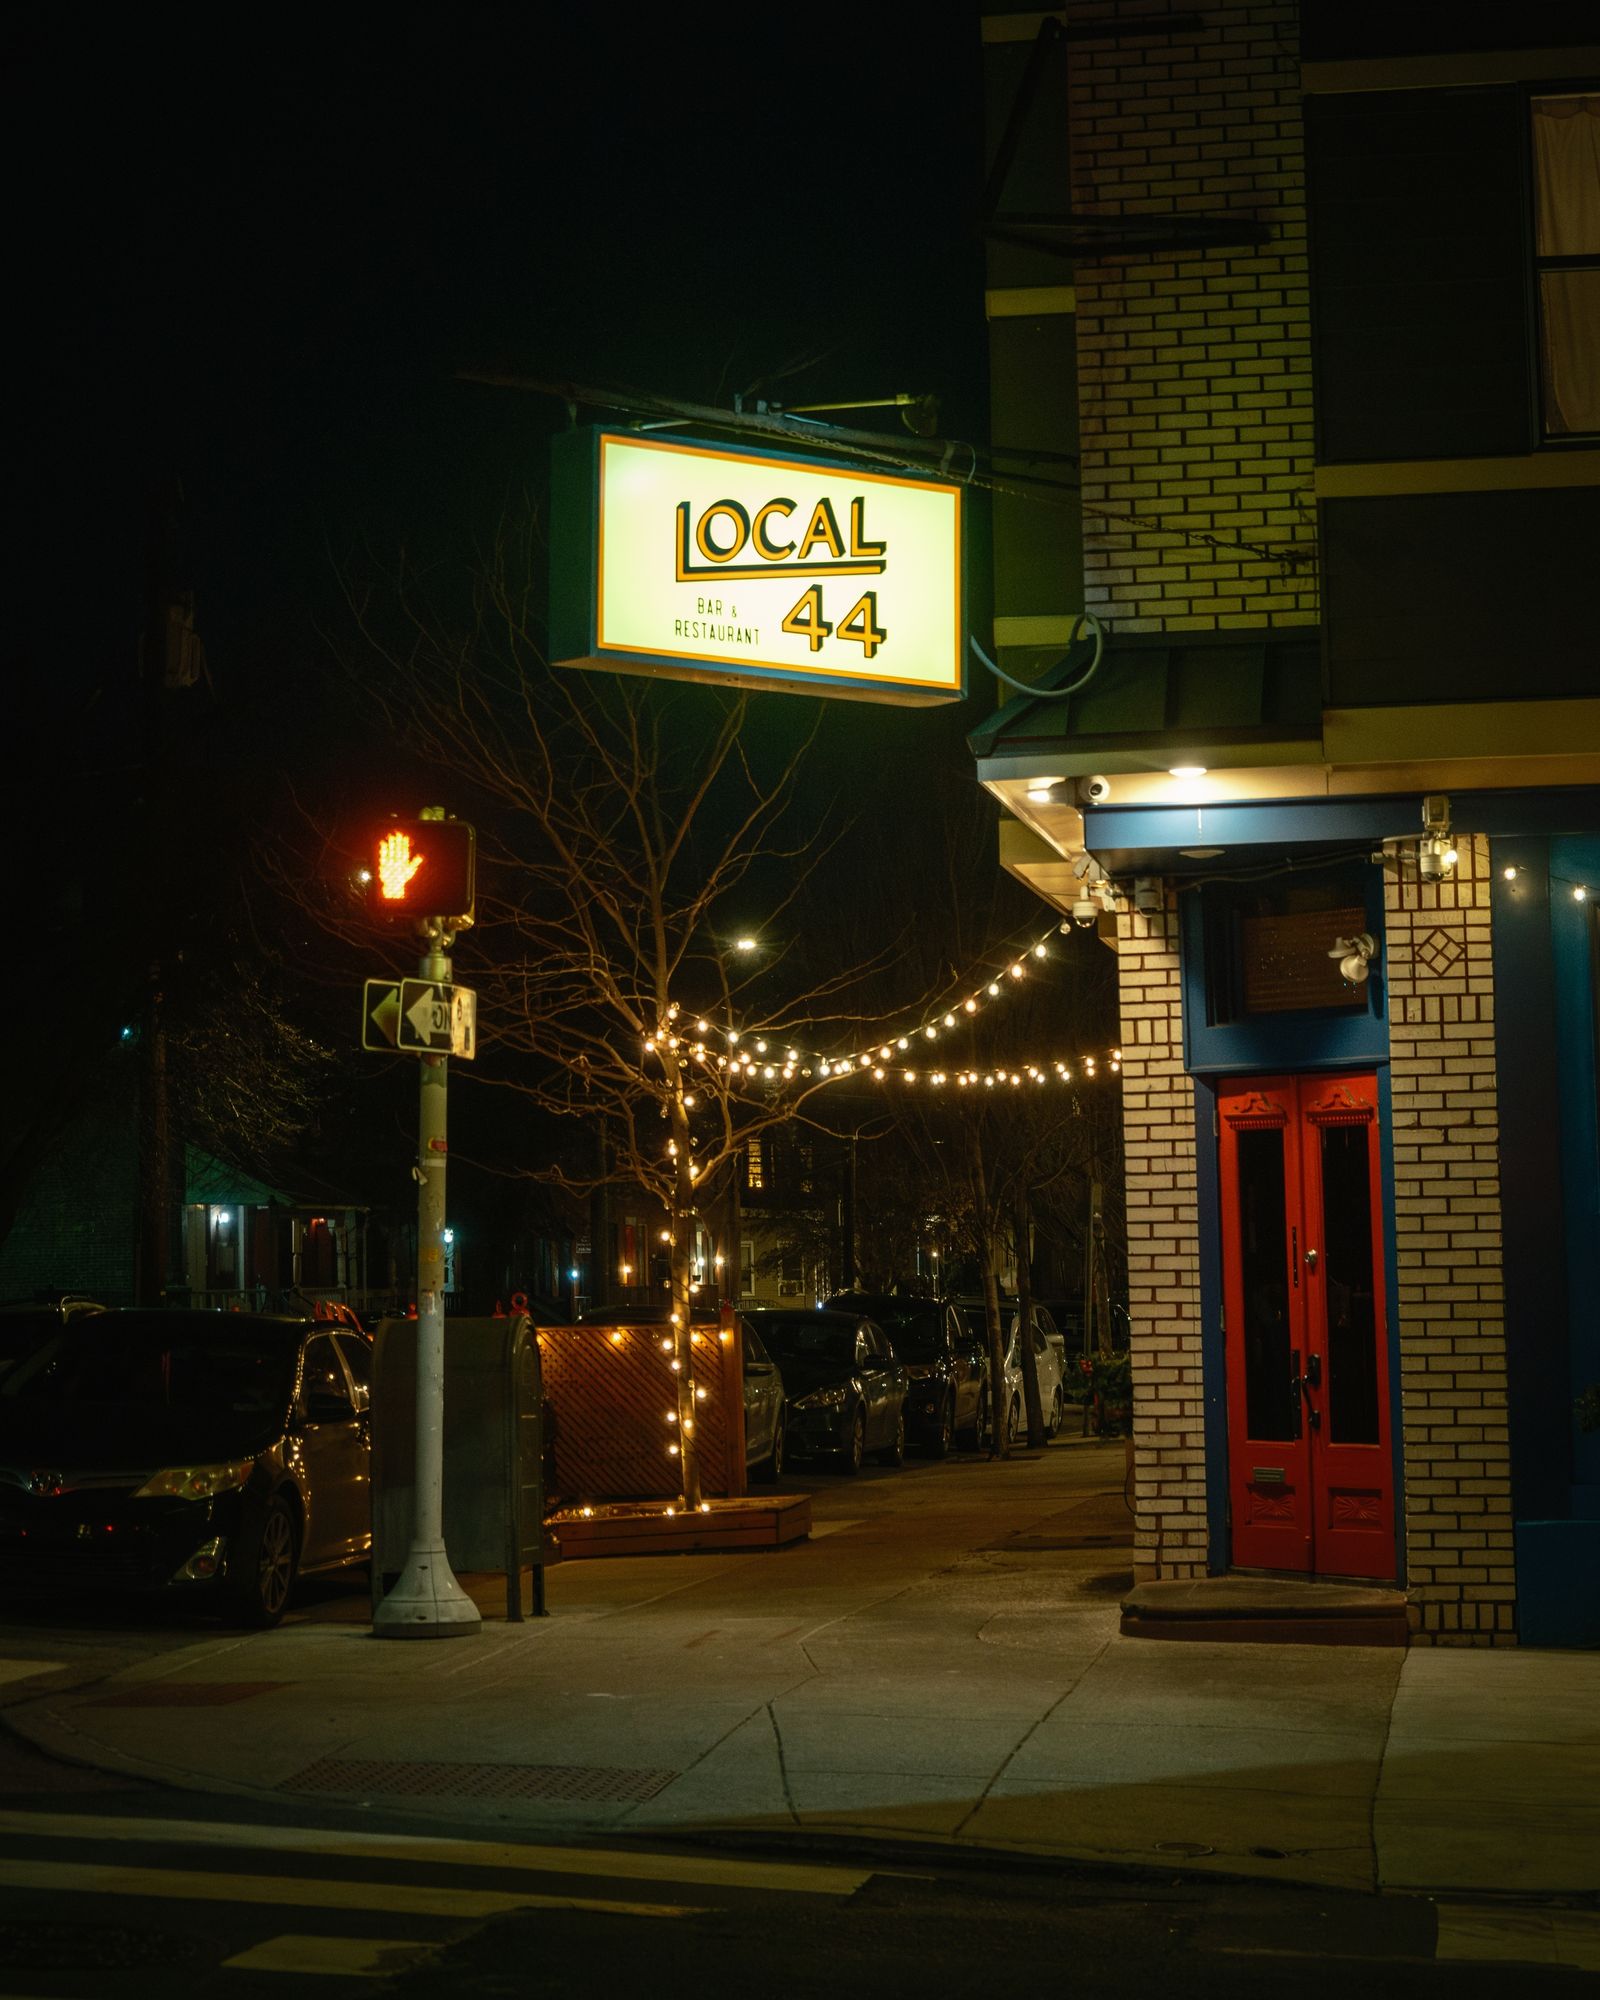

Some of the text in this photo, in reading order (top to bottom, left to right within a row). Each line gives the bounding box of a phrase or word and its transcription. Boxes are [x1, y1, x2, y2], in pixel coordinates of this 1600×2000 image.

[675, 496, 887, 582] LOCAL
[697, 597, 737, 618] BAR &
[675, 619, 759, 645] RESTAURANT
[781, 584, 887, 658] 44
[432, 1004, 452, 1030] ON
